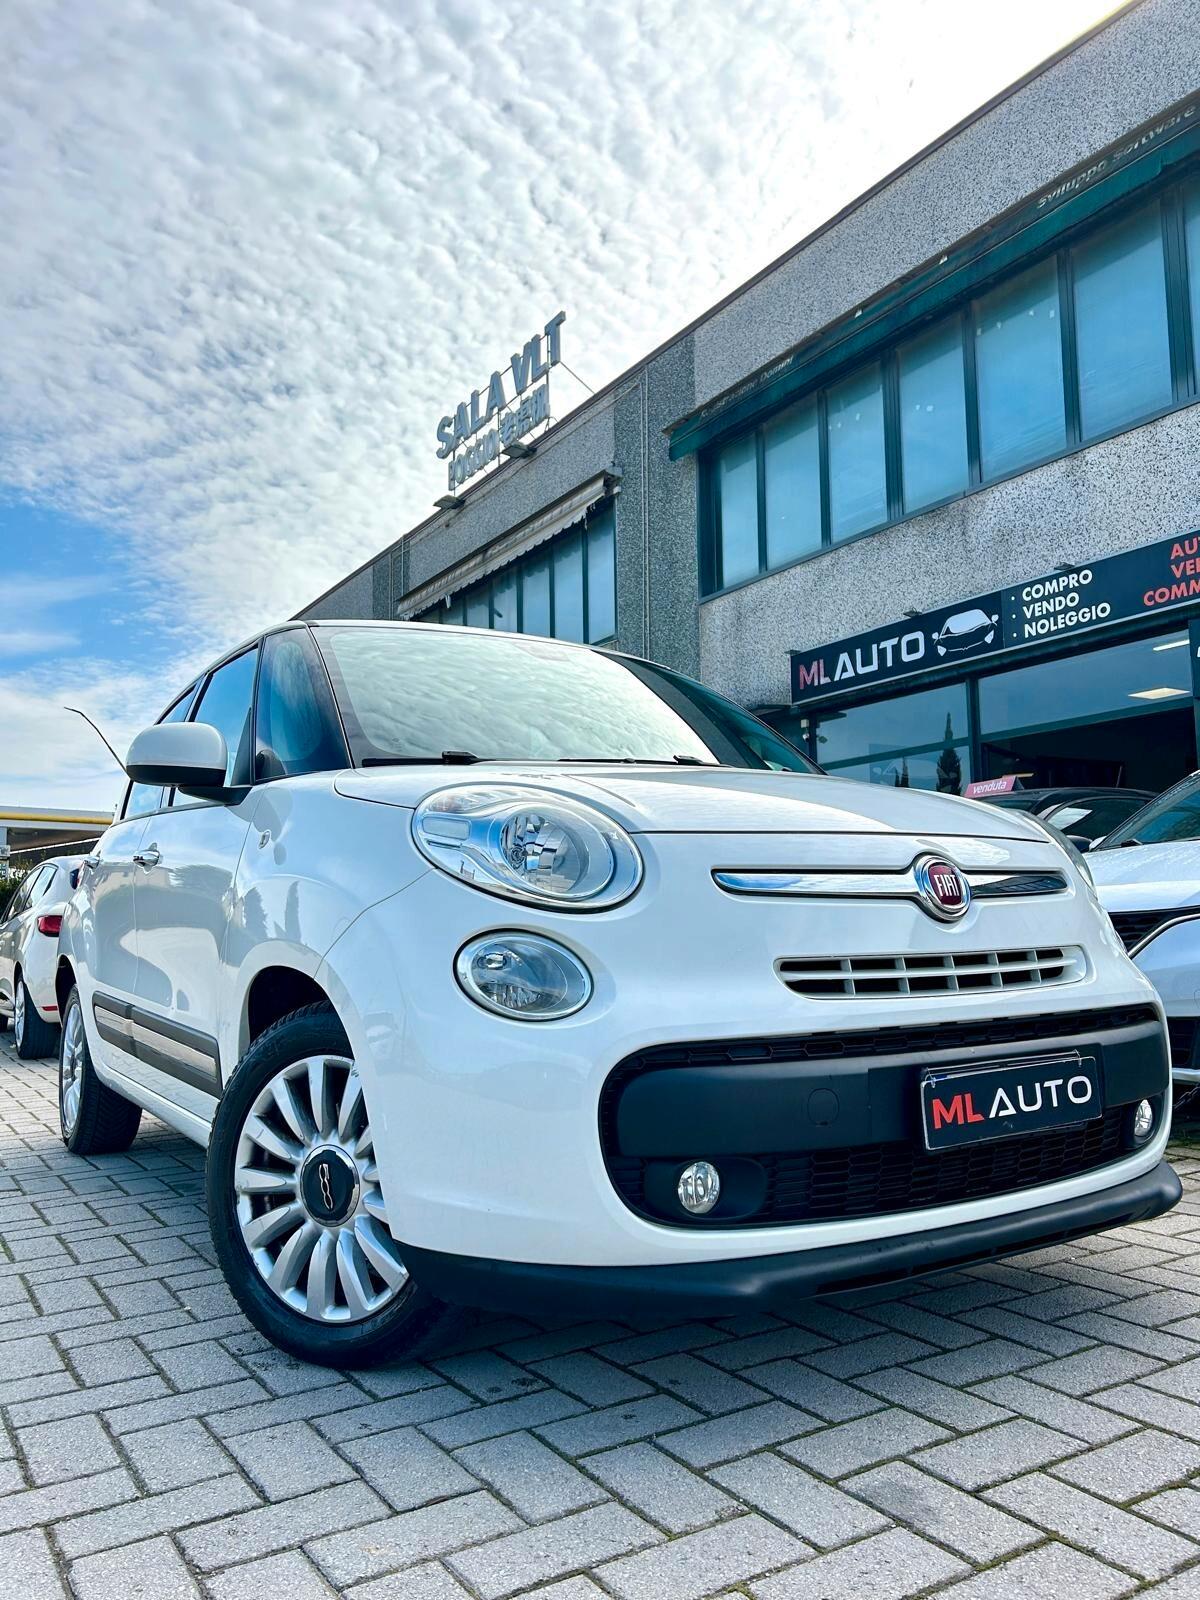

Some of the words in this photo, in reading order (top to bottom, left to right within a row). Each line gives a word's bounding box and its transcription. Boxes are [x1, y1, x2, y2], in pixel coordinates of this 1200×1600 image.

[436, 370, 506, 459] SALA
[510, 310, 566, 396] VLT
[1170, 536, 1200, 560] AU
[1022, 569, 1092, 602] COMPRO
[1022, 592, 1080, 620] VENDO
[1024, 602, 1111, 639] NOLEGGIO
[973, 778, 1007, 795] venduta
[933, 874, 960, 897] FIAT
